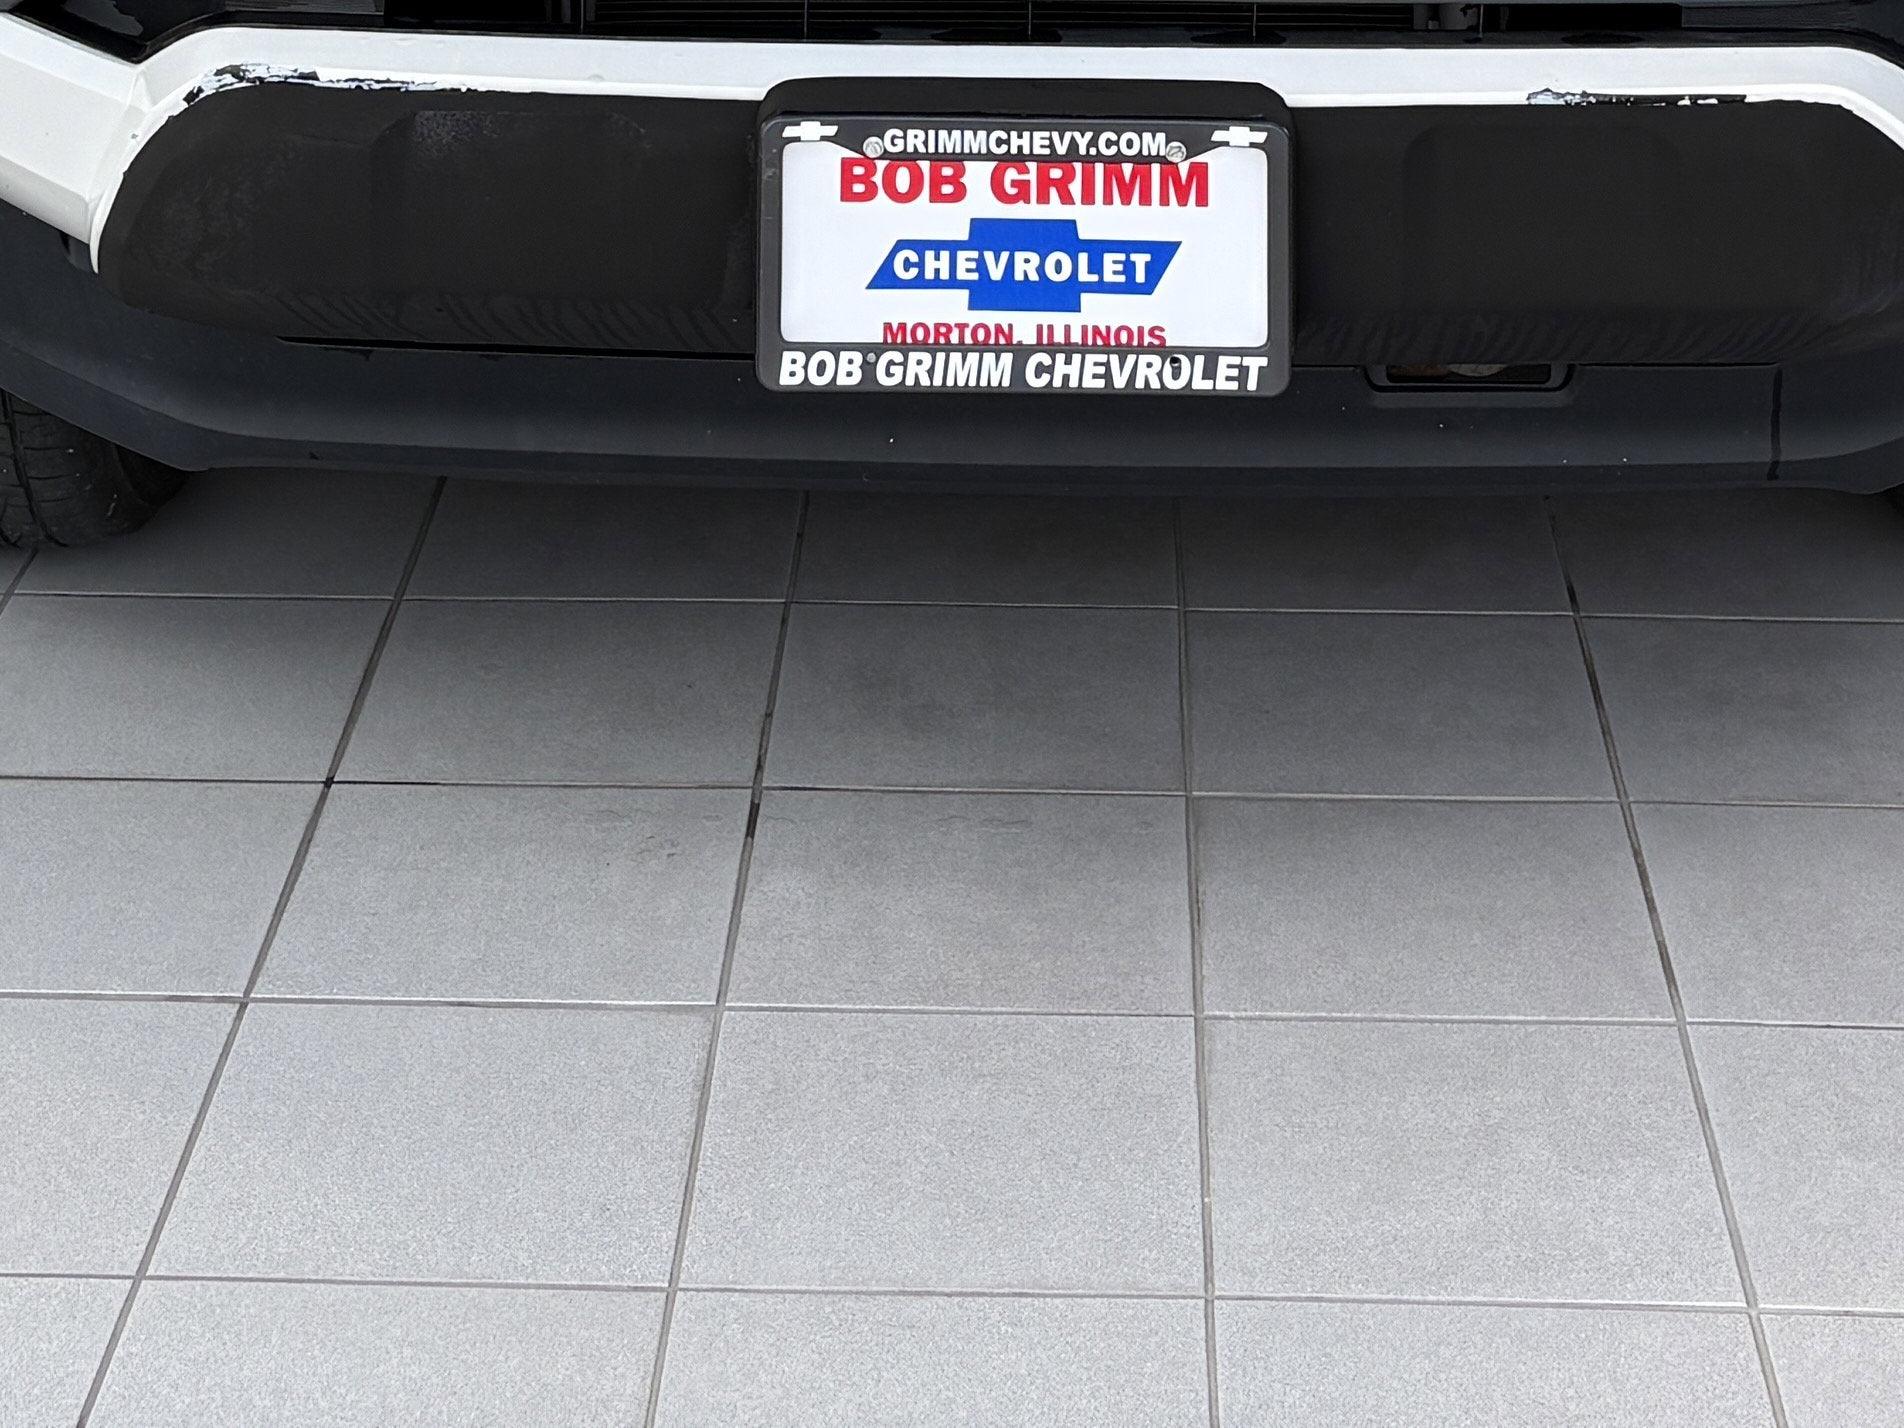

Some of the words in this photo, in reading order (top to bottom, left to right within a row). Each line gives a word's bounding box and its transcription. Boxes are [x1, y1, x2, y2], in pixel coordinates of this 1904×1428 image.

[883, 128, 1167, 157] GRIMMCHEVY.COM
[839, 156, 967, 204] BOB
[990, 160, 1209, 207] GRIMM
[892, 248, 1152, 284] CHEVROLET
[1035, 323, 1167, 347] ILLINOIS
[779, 350, 863, 386] BOB
[875, 351, 1012, 388] GRIMM
[1025, 352, 1268, 392] CHEVROLET
